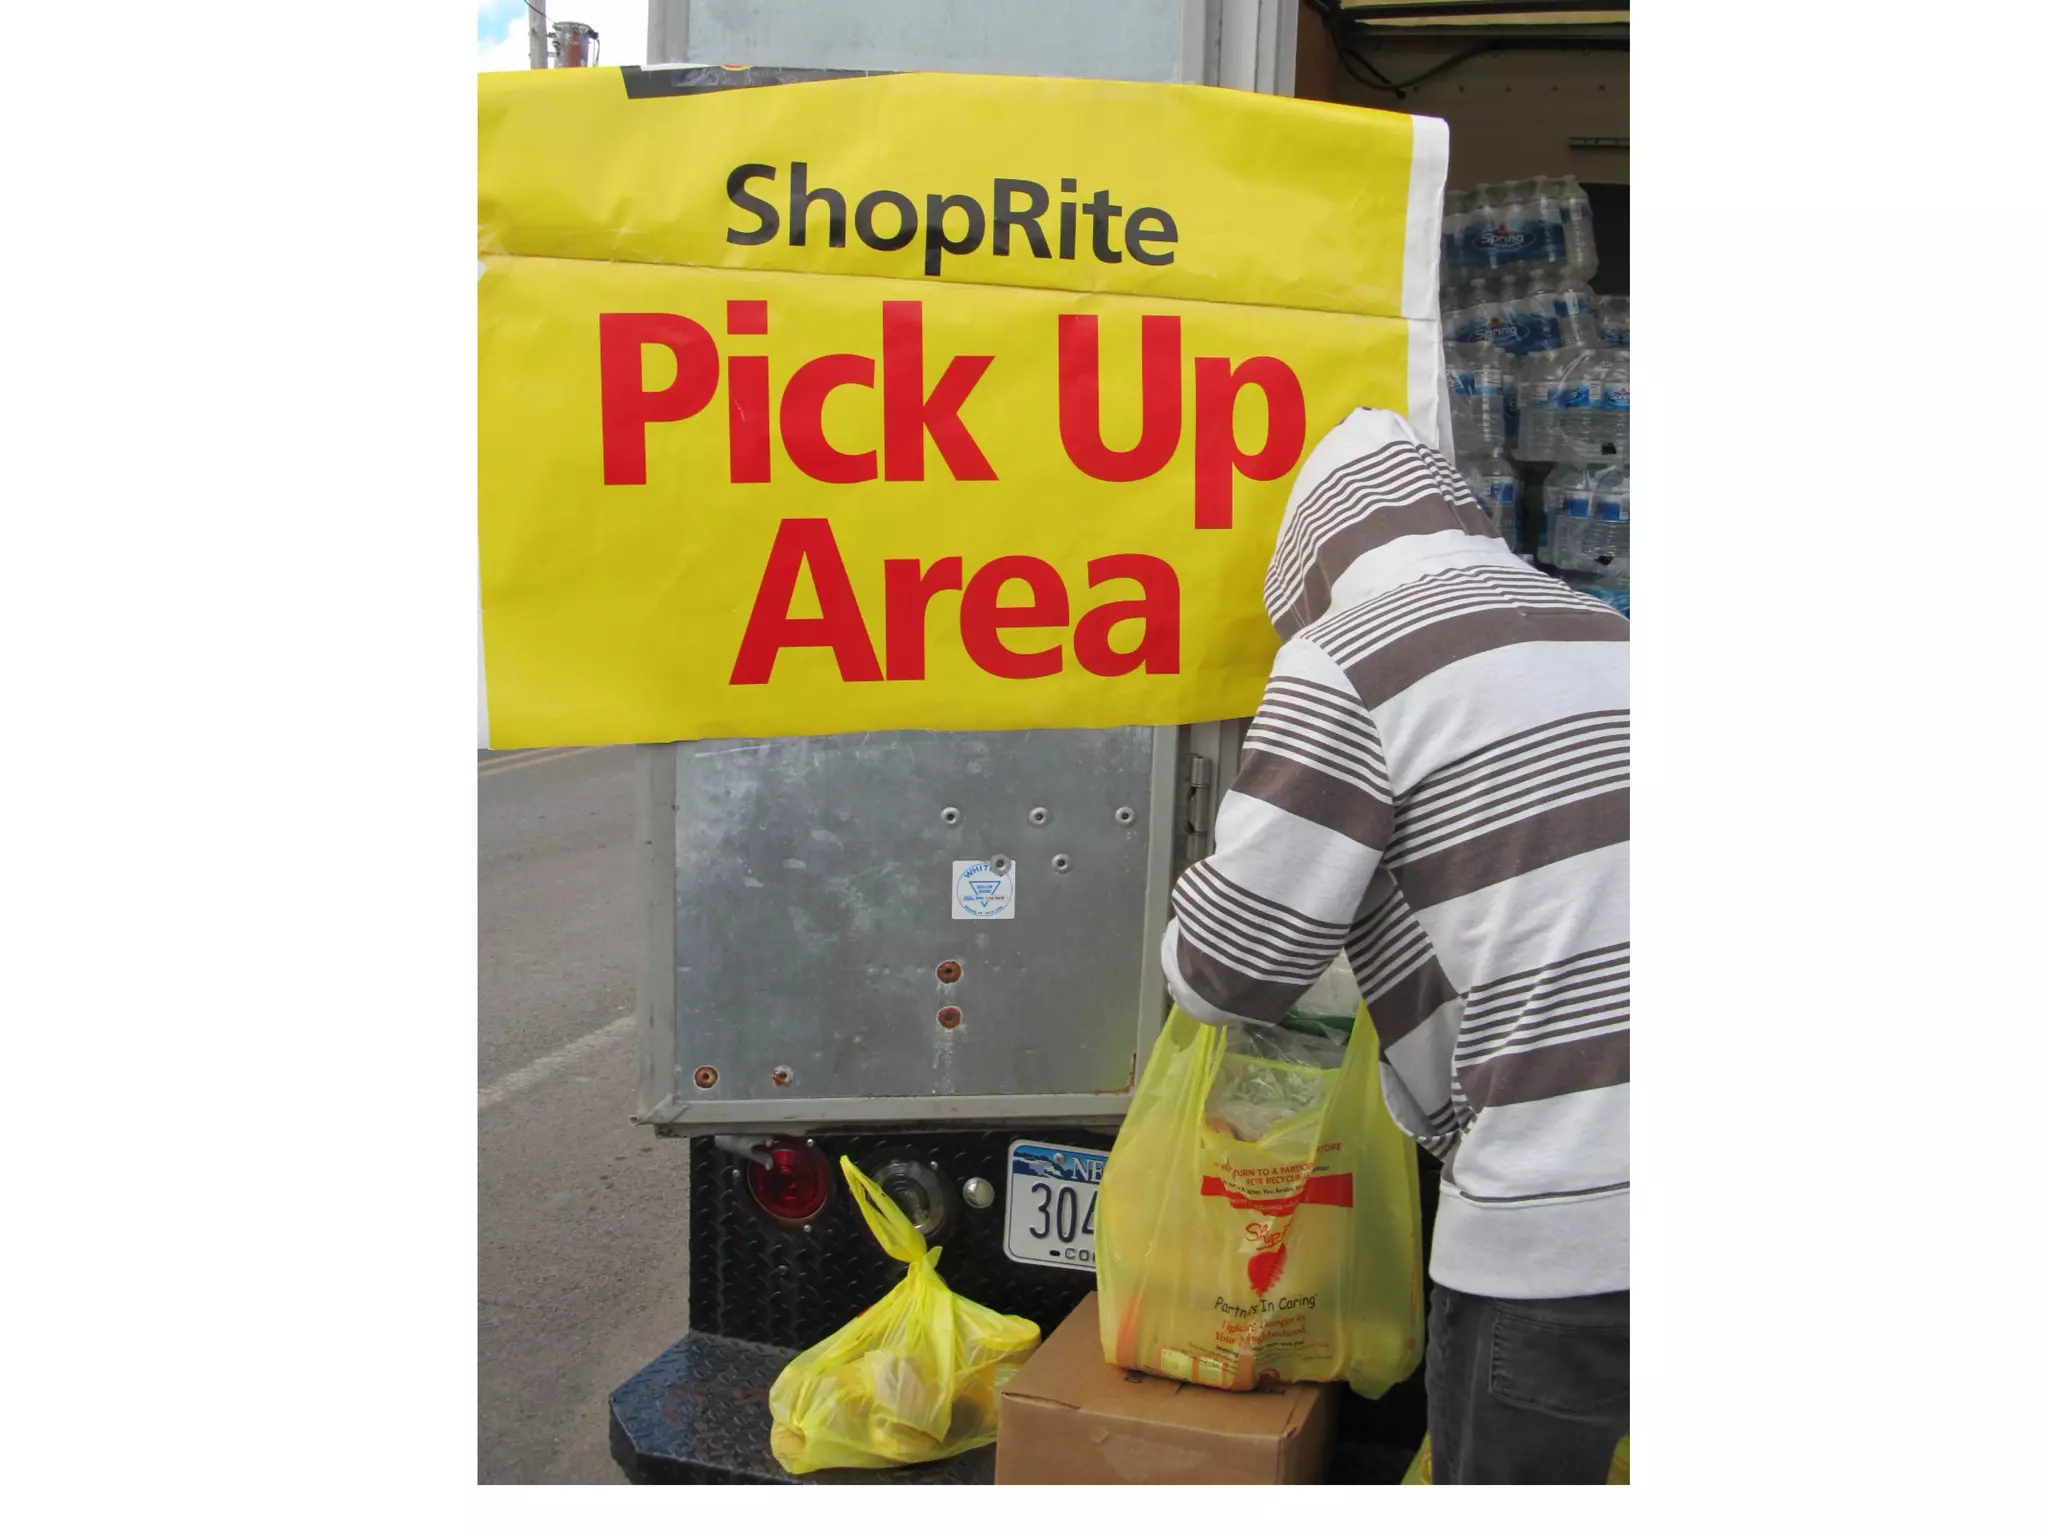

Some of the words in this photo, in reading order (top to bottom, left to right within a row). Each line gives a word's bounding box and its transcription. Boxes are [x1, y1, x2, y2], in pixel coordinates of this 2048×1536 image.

[726, 161, 1179, 277] ShopRite
[1481, 231, 1524, 246] Spring
[599, 300, 999, 486] Pick
[1058, 314, 1307, 530] Up
[729, 517, 1181, 686] Area
[1257, 1168, 1270, 1176] TO
[1271, 1167, 1279, 1175] A
[1246, 1178, 1263, 1186] FOR
[1260, 1299, 1275, 1313] In
[1279, 1294, 1316, 1311] Caring
